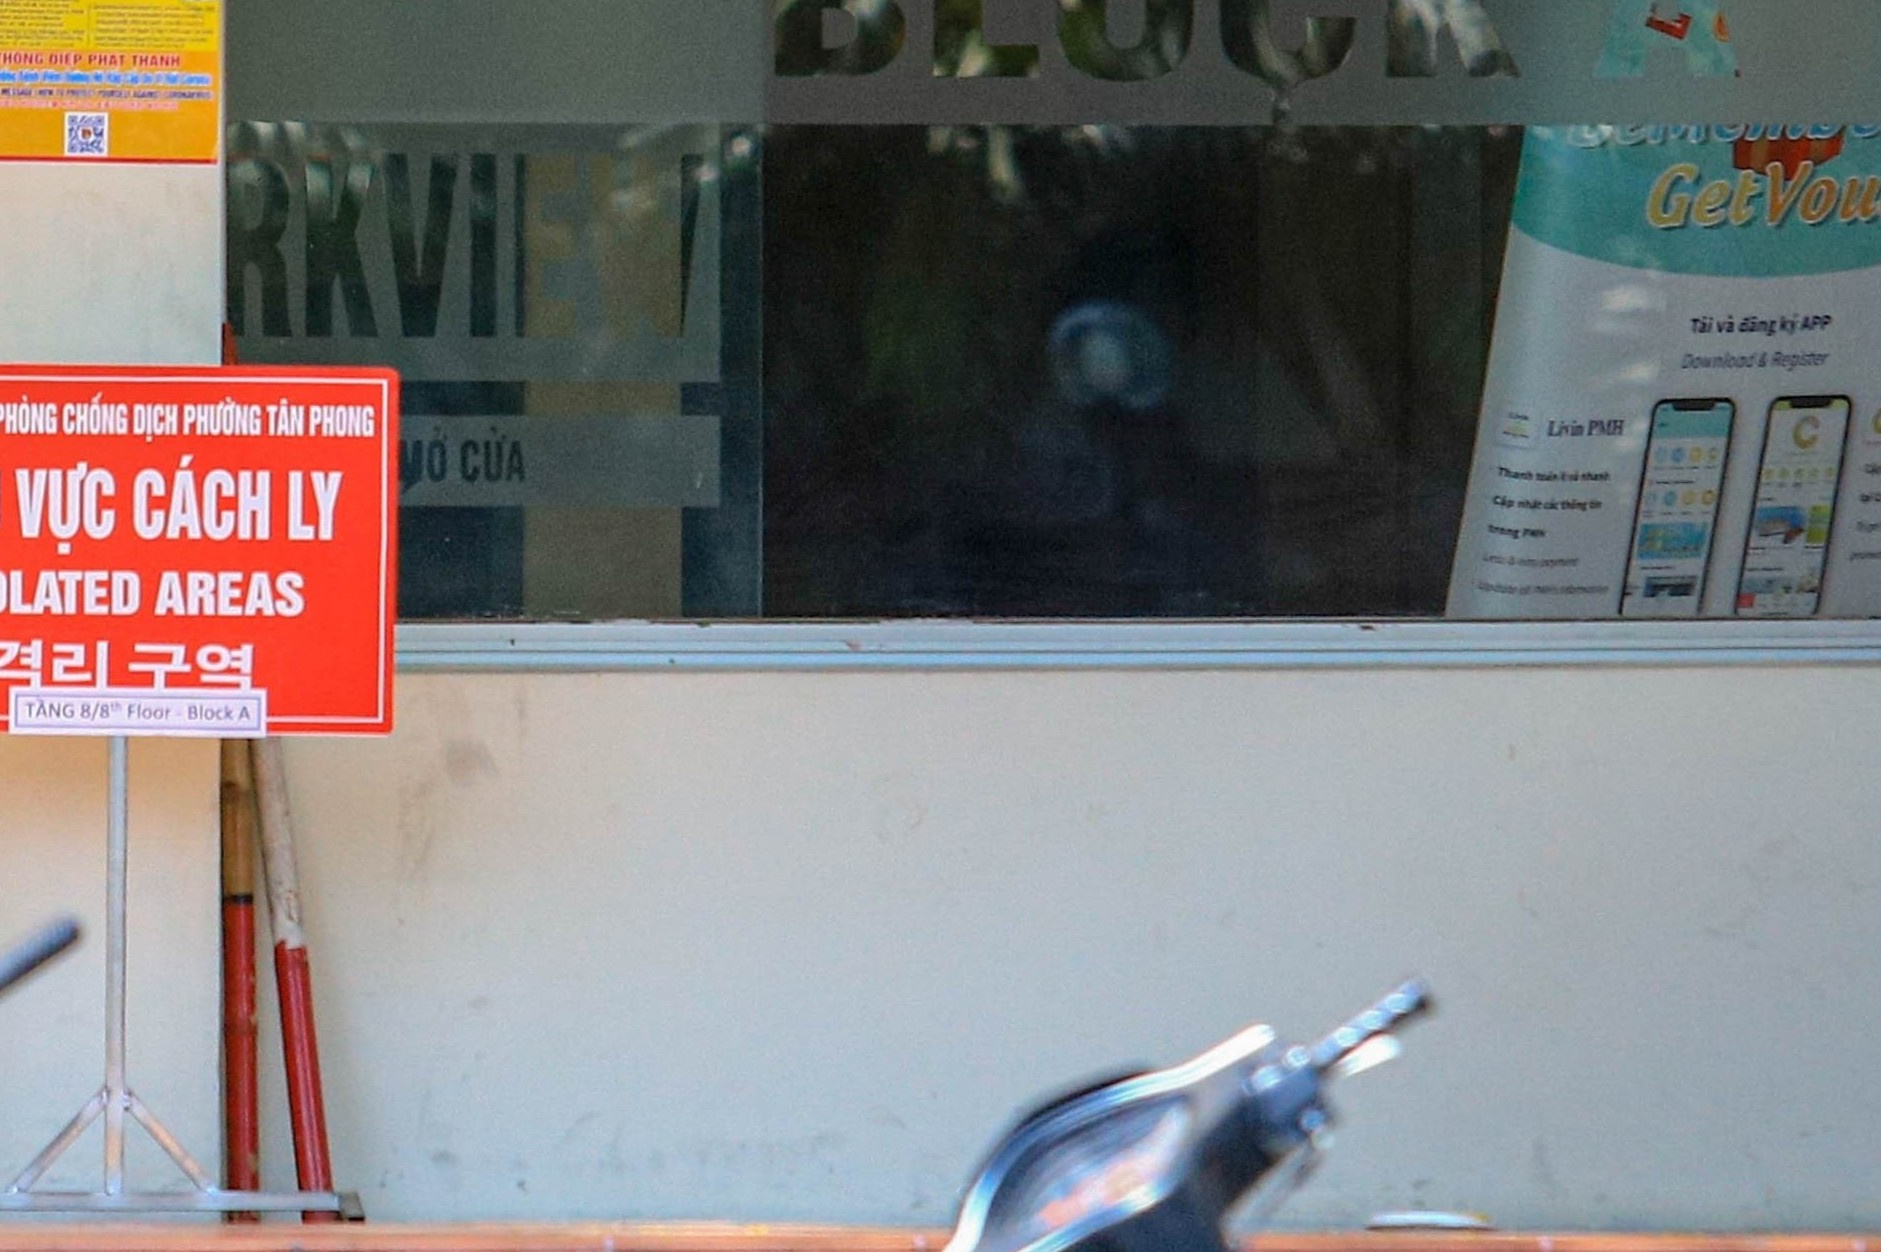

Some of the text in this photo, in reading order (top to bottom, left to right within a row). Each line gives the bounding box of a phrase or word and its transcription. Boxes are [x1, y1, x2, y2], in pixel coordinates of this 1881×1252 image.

[1800, 314, 1833, 330] APP
[1681, 353, 1756, 369] Download
[1770, 352, 1830, 371] Register
[62, 392, 128, 435] CHỐNG
[133, 403, 178, 443] DỊCH
[183, 396, 262, 436] PHƯỜNG
[266, 398, 305, 437] TÂN
[309, 405, 375, 438] PHONG
[460, 426, 526, 483] CỬA
[15, 461, 115, 555] VỰC
[133, 454, 271, 540] CÁCH
[288, 470, 344, 541] LY
[155, 571, 304, 617] AREAS
[128, 643, 254, 690] 구역
[127, 703, 170, 719] Floor
[188, 704, 234, 720] Block
[239, 705, 251, 720] A
